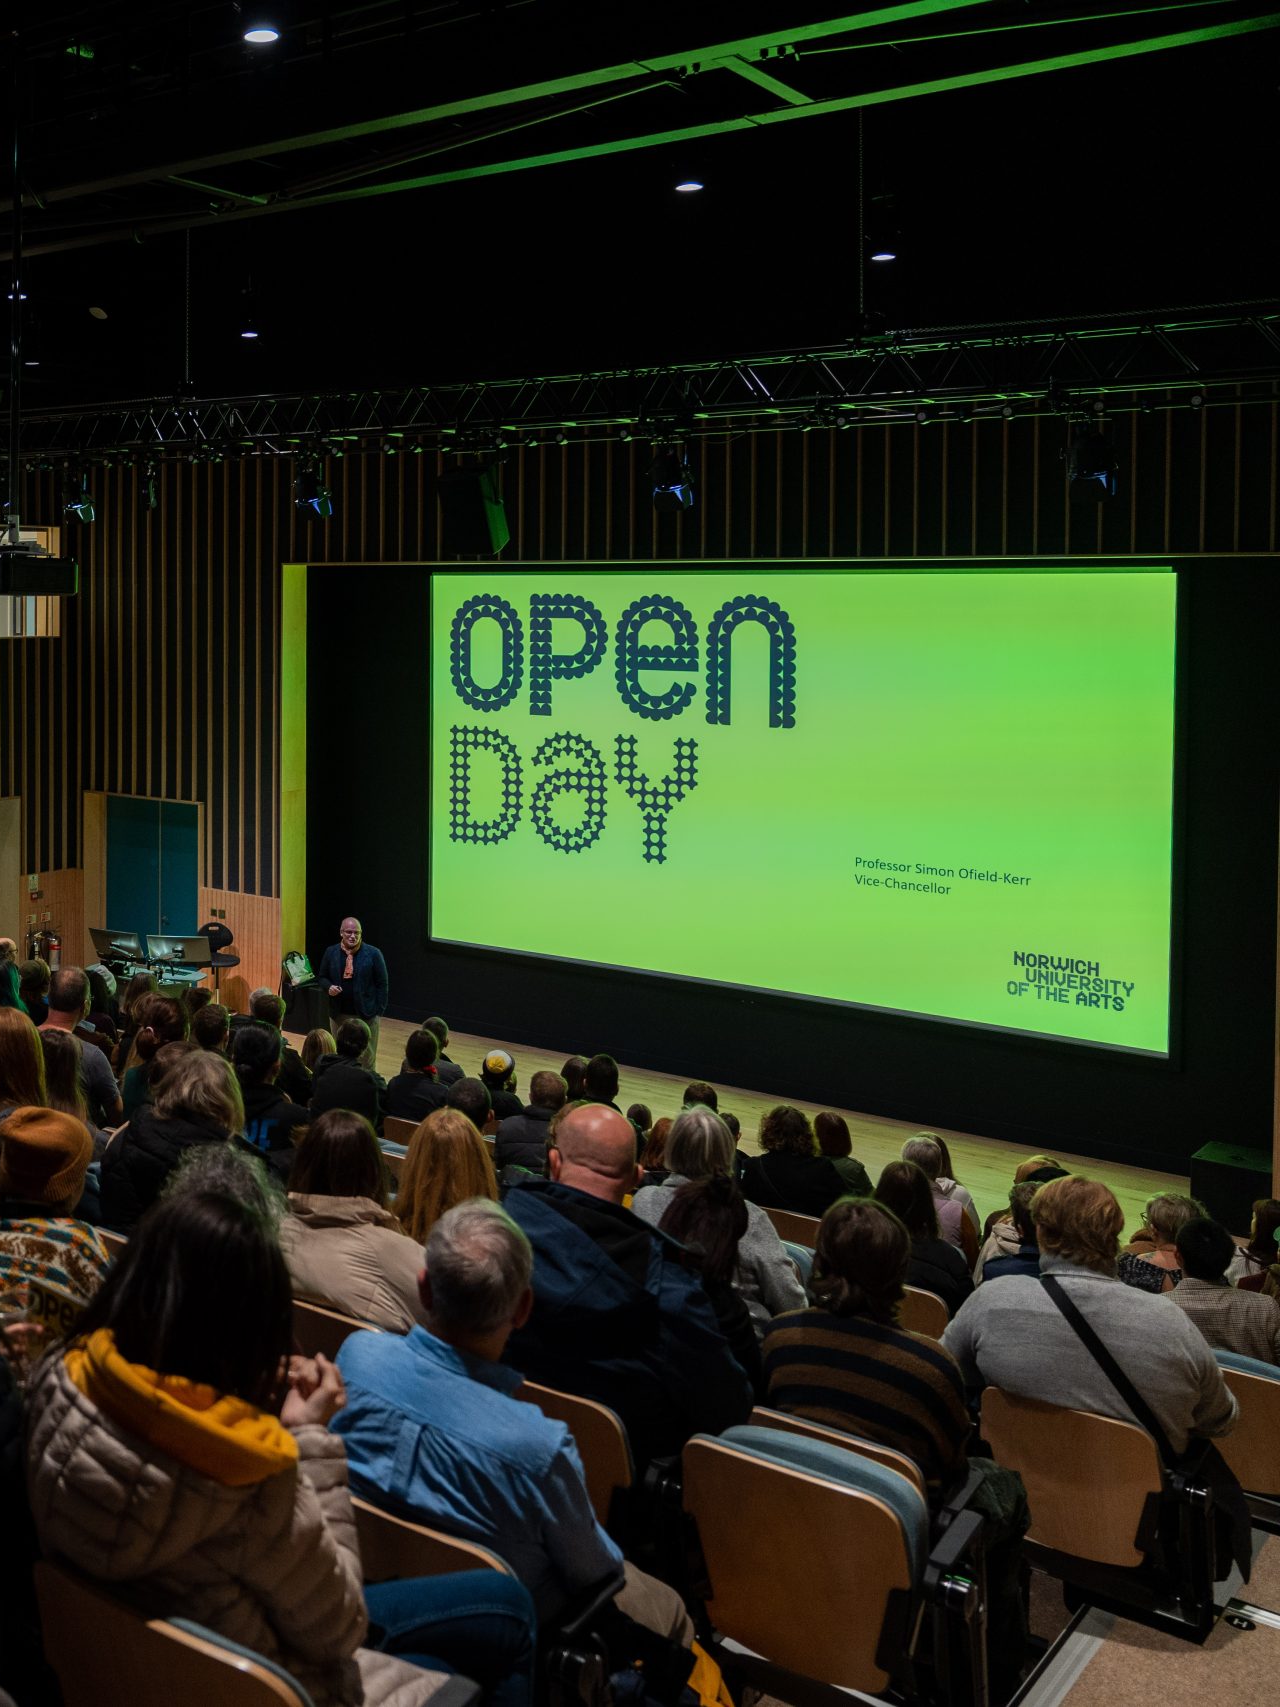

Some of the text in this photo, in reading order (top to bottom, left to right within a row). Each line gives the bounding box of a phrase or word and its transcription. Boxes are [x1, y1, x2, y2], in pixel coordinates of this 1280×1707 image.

[854, 873, 952, 895] Vice-Chancellor
[855, 856, 1032, 886] Professor Simon Ofield-Kerr
[1013, 950, 1100, 977] NORWICH
[1006, 980, 1125, 1012] OF THE ARTS
[1025, 967, 1135, 998] UNIVERSITY
